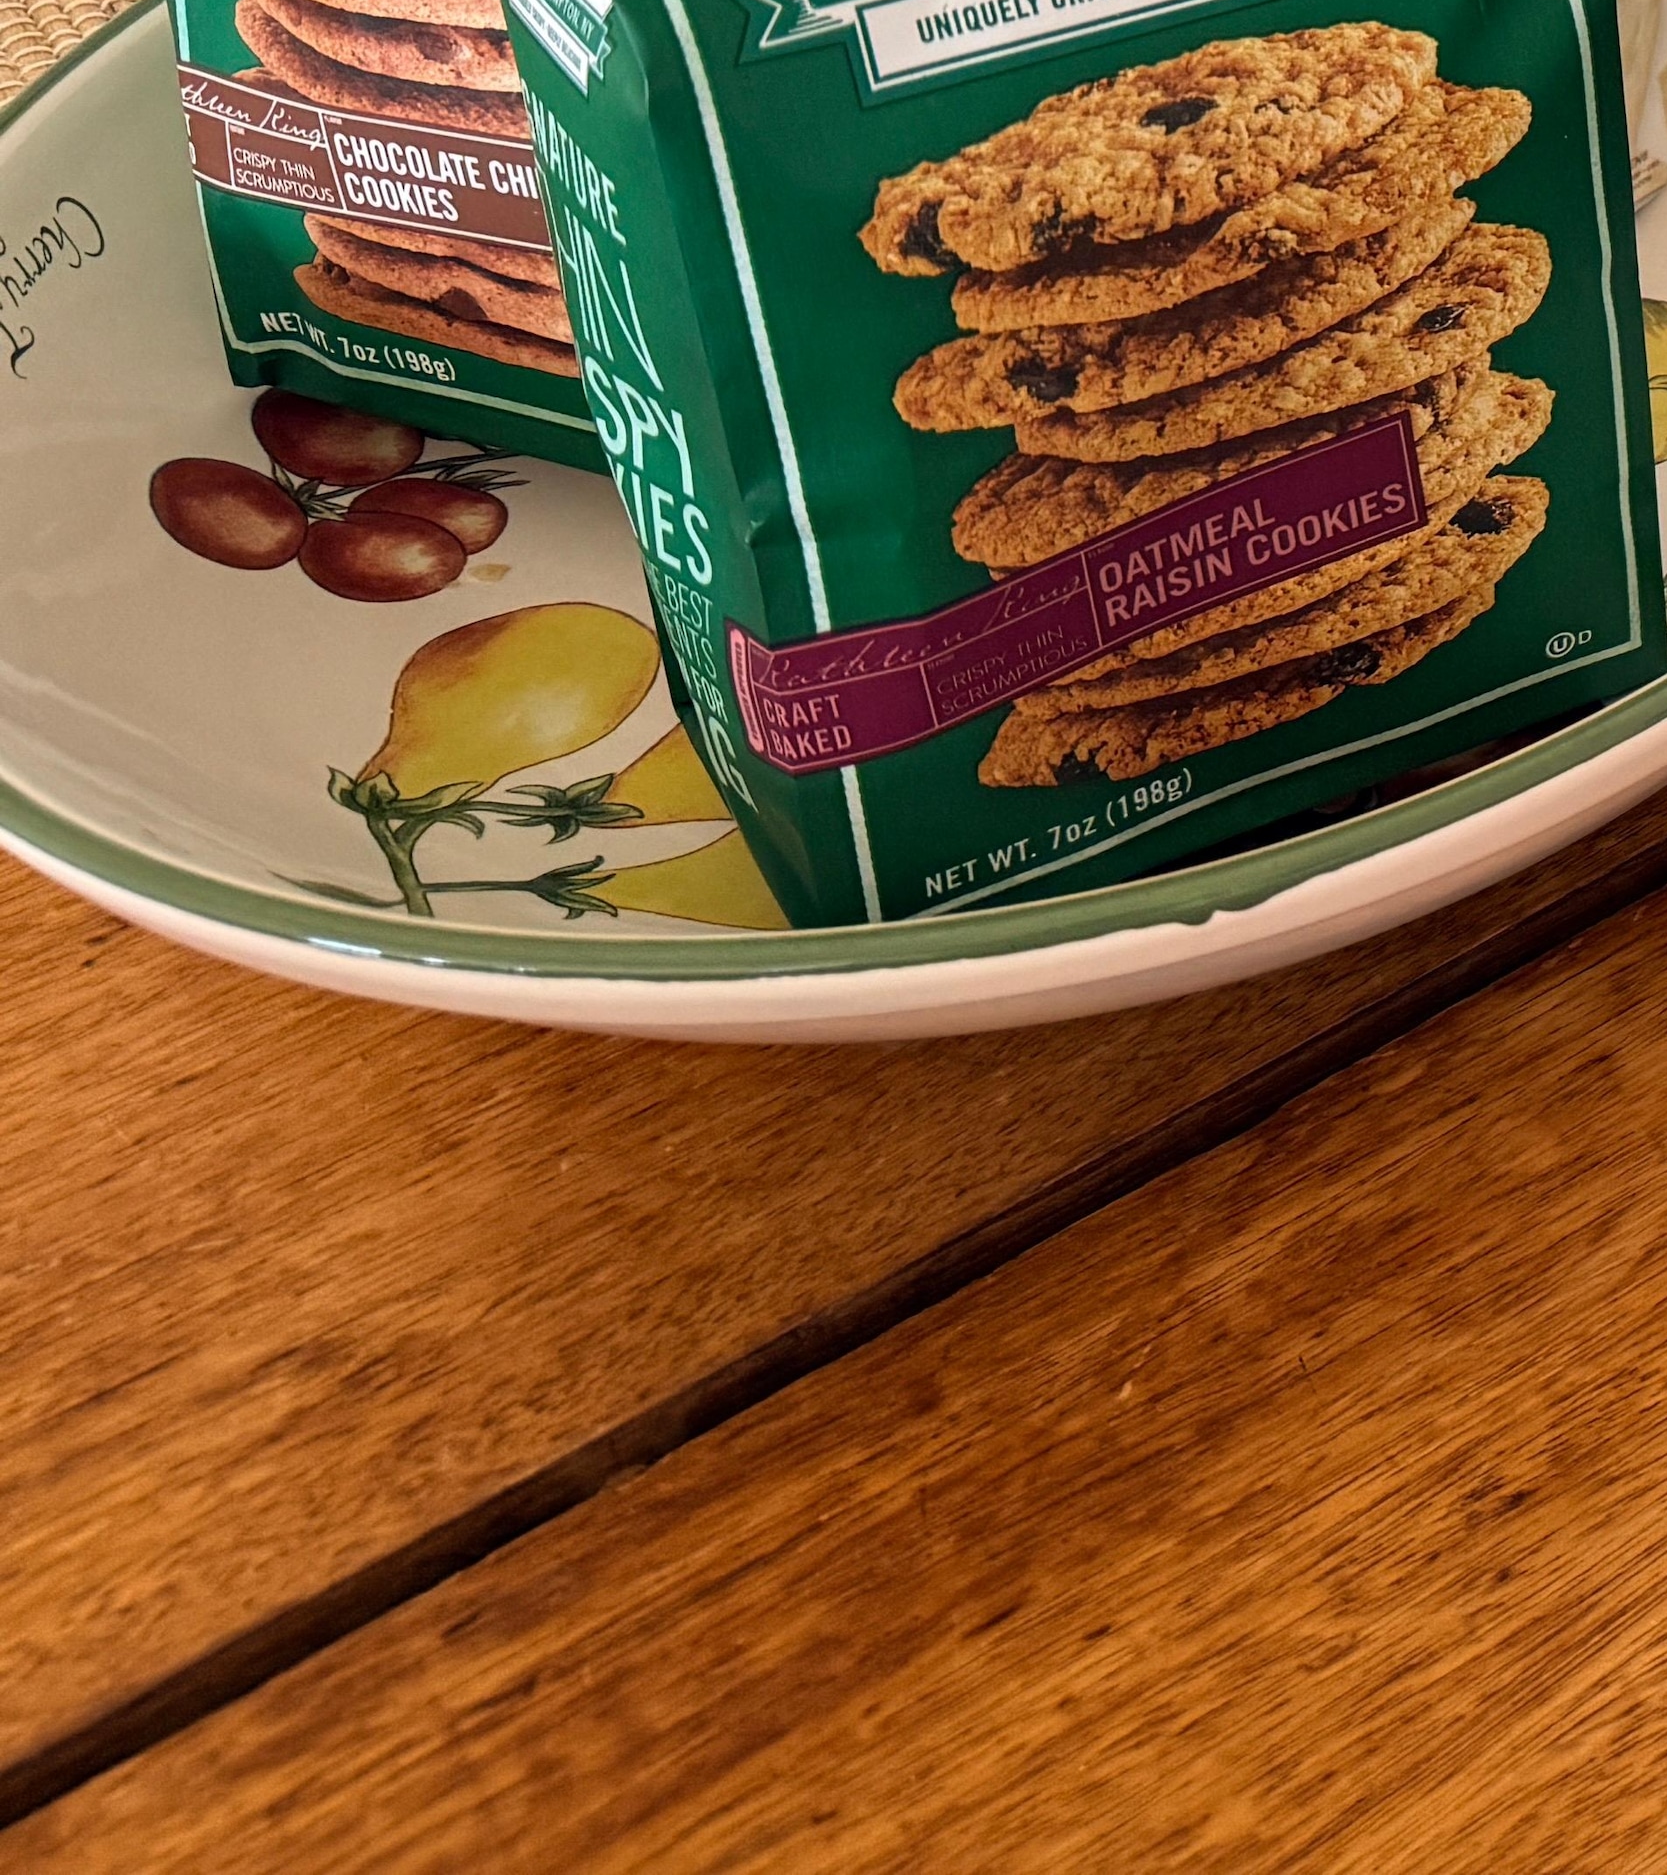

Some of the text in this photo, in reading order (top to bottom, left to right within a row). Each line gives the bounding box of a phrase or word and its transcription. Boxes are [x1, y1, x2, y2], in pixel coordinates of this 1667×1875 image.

[233, 146, 316, 182] CRISPY THIN
[236, 169, 336, 204] SCRUMPTIOUS
[335, 135, 486, 192] CHOCOLATE
[343, 171, 459, 221] COOKIES
[337, 335, 381, 365] 7oz
[386, 349, 456, 382] (198g)
[1097, 497, 1277, 591] OATMEAL
[1104, 481, 1409, 628] RAISIN COOKIES
[936, 624, 1065, 697] CRISPY THIN
[940, 635, 1088, 718] SCRUMPTIOUS
[762, 693, 841, 729] CRAFT
[770, 725, 853, 762] BAKED
[924, 769, 1194, 899] NET WT. 7oz (198g)
